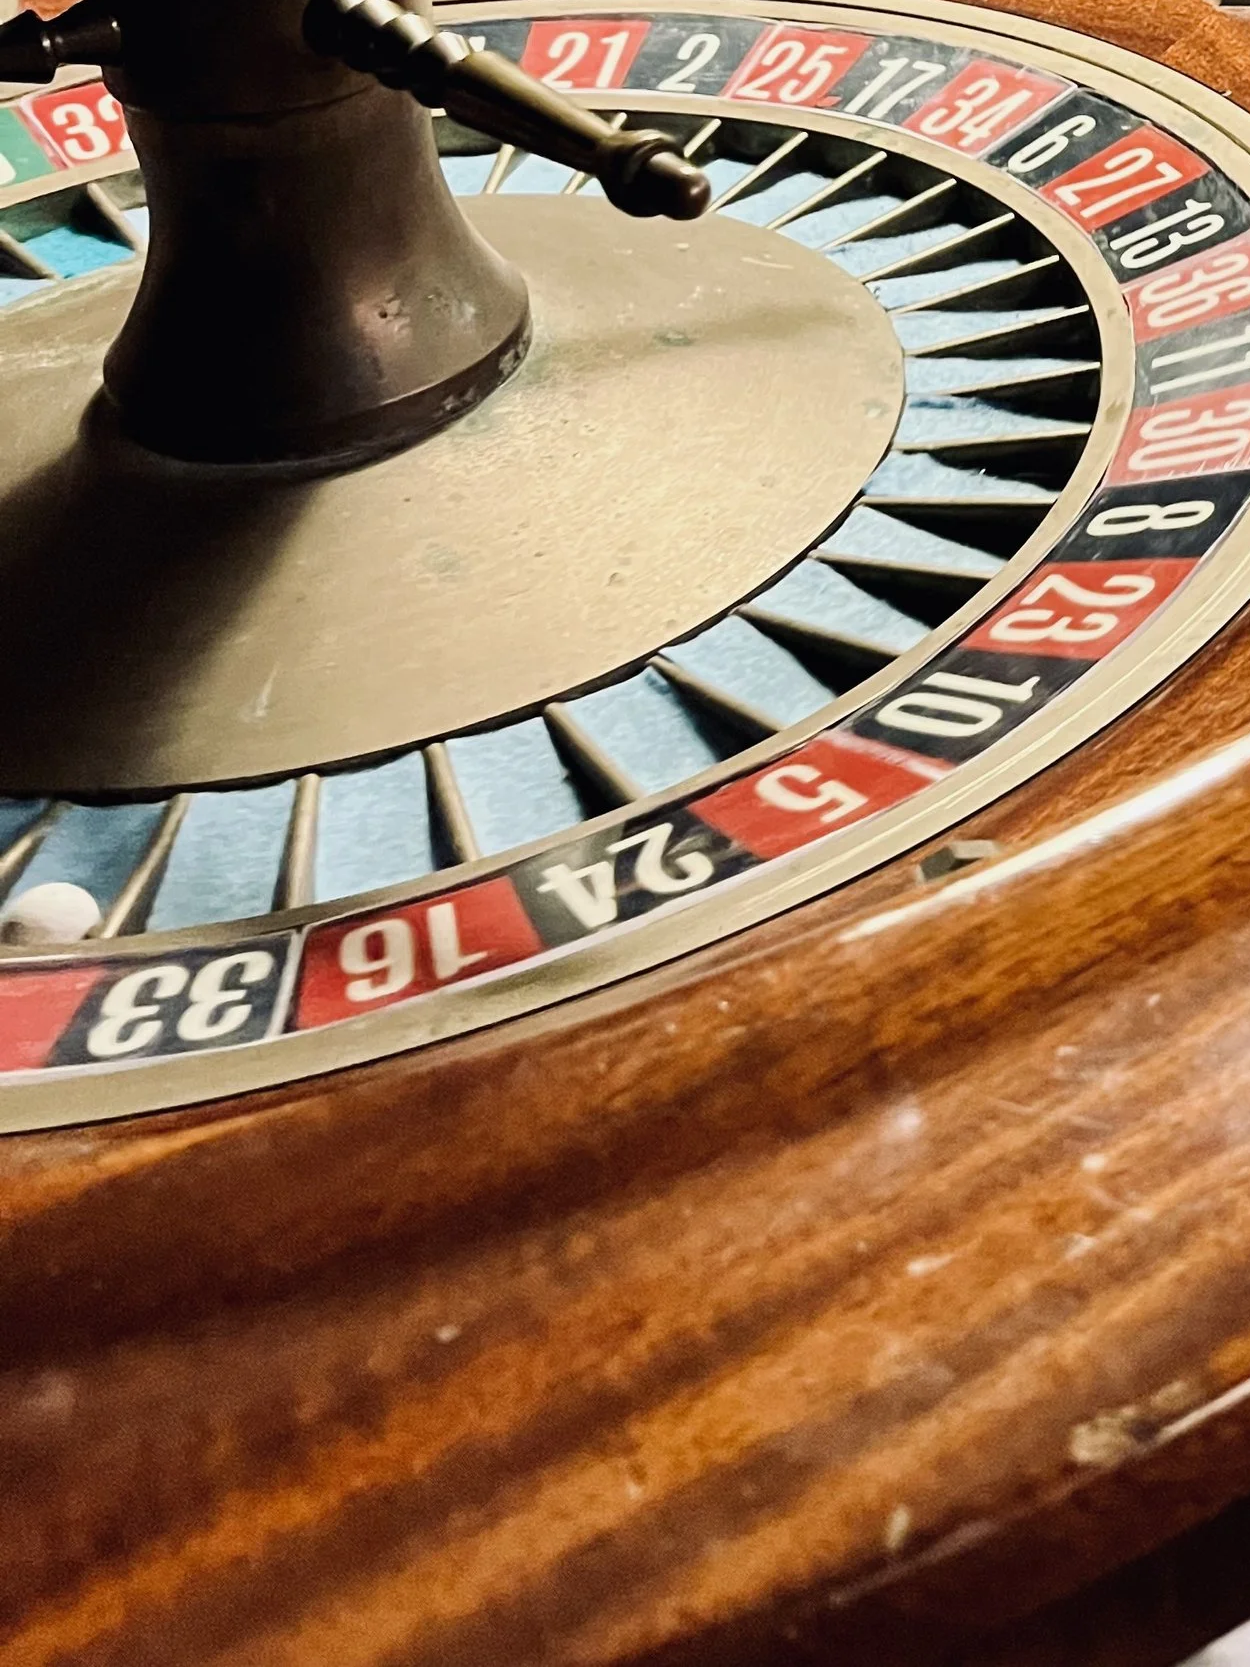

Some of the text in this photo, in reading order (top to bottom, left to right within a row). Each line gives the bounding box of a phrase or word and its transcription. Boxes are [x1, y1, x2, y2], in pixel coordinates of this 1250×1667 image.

[540, 31, 630, 89] 21
[655, 33, 720, 93] 2
[736, 40, 834, 102] 25
[843, 57, 945, 117] 17
[919, 77, 1024, 147] 34
[1007, 114, 1096, 172] 6
[1053, 146, 1183, 214] 27
[1110, 197, 1224, 269] 13
[1086, 500, 1214, 536] 8
[989, 573, 1155, 643] 23
[876, 671, 1040, 737] 10
[754, 764, 868, 823] 5
[537, 823, 714, 929] 24
[337, 902, 488, 1002] 16
[86, 950, 274, 1058] 33
